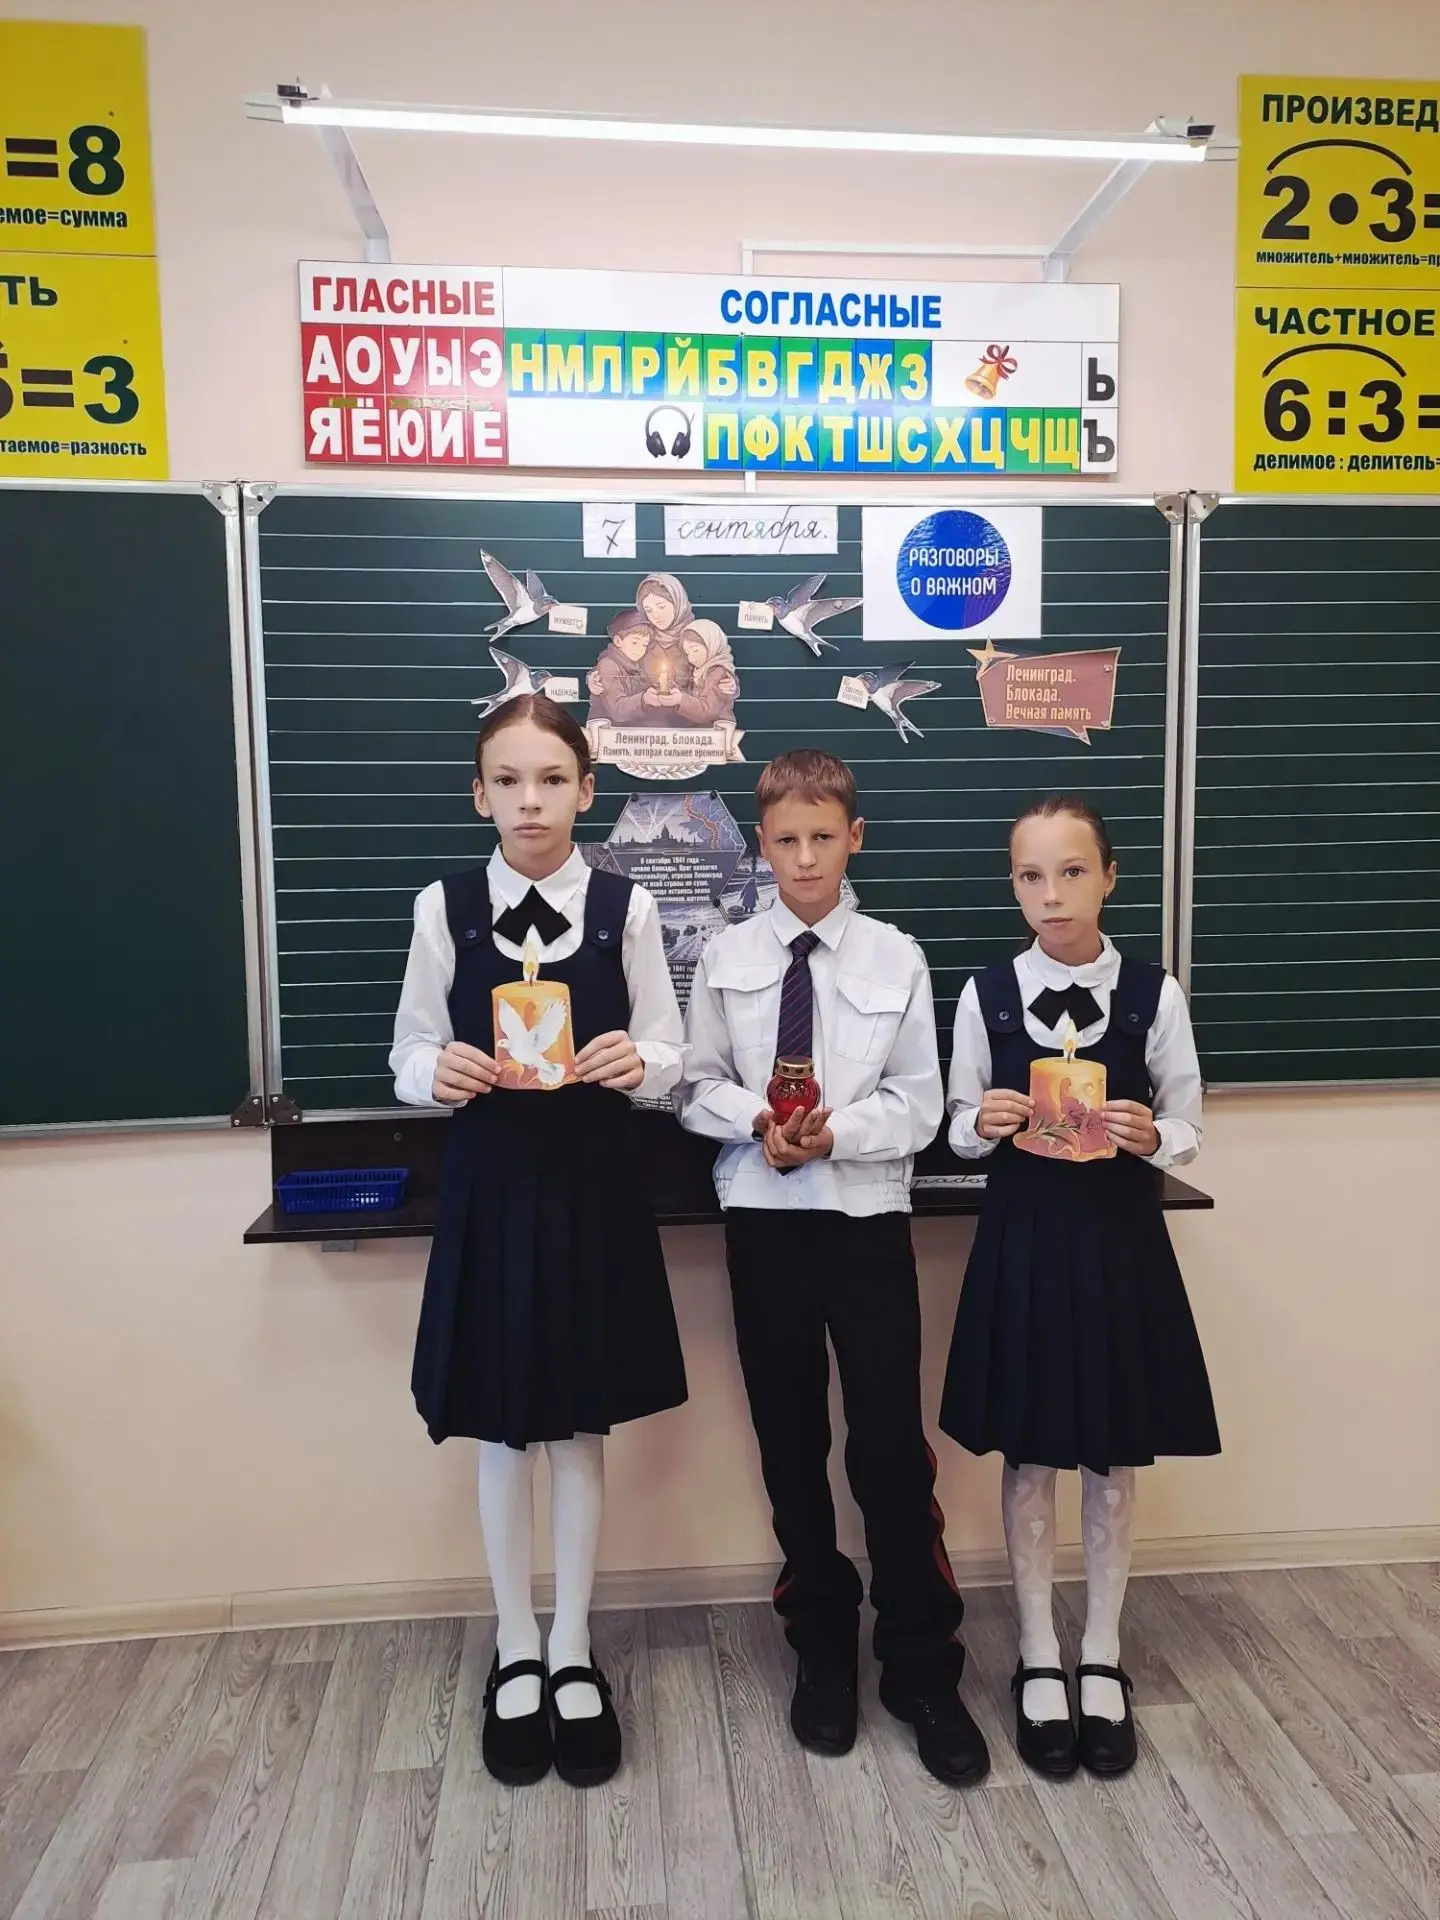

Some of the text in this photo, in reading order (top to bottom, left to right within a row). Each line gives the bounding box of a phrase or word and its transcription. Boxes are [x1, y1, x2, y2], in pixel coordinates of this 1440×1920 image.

[1262, 94, 1439, 133] ПРОИЗВЕД
[0, 275, 58, 306] ТЬ
[312, 276, 495, 316] ГЛАСНЫЕ
[720, 289, 942, 328] СОГЛАСНЫЕ
[1254, 307, 1435, 336] ЧАСТНОЕ
[1253, 453, 1335, 471] делимое
[602, 519, 625, 554] 7
[909, 548, 1000, 567] РАЗГОВОРЫ
[911, 576, 997, 596] О ВАЖНОМ
[1006, 664, 1076, 684] Ленинград.
[1006, 684, 1061, 703] Блокада.
[1006, 704, 1091, 721] Вечная память
[615, 732, 715, 746] Ленинград. Блокада.
